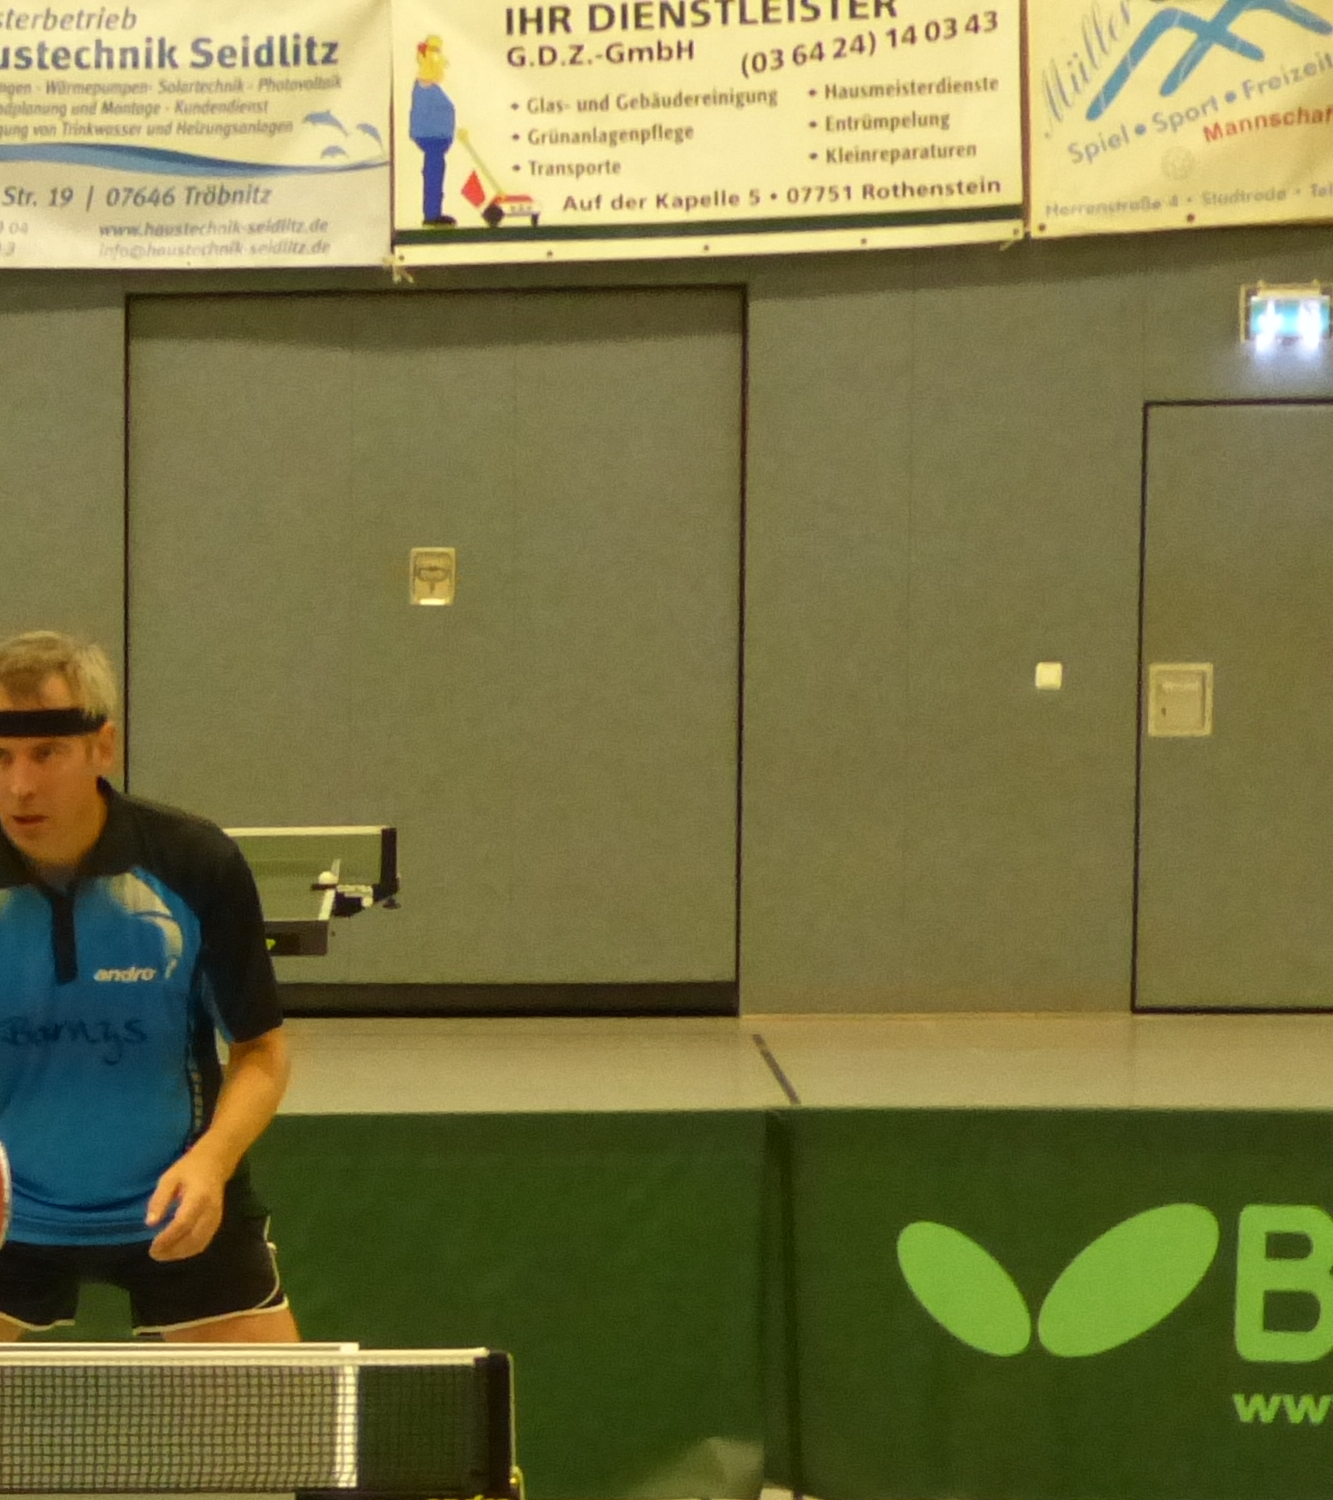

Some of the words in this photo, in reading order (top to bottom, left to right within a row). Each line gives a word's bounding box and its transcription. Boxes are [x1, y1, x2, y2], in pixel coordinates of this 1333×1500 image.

[505, 5, 573, 36] IHR
[588, 0, 899, 32] DIENSTLEISTER
[190, 33, 339, 69] Seidlitz
[506, 39, 695, 68] G.D.Z.-GmbH
[741, 48, 785, 79] (03
[792, 41, 826, 67] 64
[832, 30, 877, 58] 24)
[885, 24, 918, 49] 14
[924, 17, 958, 43] 03
[964, 10, 999, 34] 43
[577, 94, 610, 112] und
[615, 87, 779, 110] Gebäudereinigung
[824, 77, 999, 100] Hausmeisterdienste
[824, 110, 951, 134] Entrümpelung
[527, 123, 695, 148] Grünanlagenpflege
[825, 142, 978, 166] Kleinreparaturen
[528, 159, 622, 180] Transporte
[1, 185, 39, 208] Str.
[48, 188, 75, 207] 19
[106, 187, 176, 208] 07646
[184, 184, 274, 207] Tröbnitz
[562, 194, 603, 213] Auf
[610, 193, 647, 211] der
[655, 189, 741, 213] Kapelle
[749, 188, 761, 206] 5
[786, 184, 853, 204] 07751
[862, 175, 1002, 200] Rothenstein
[94, 967, 157, 983] andro
